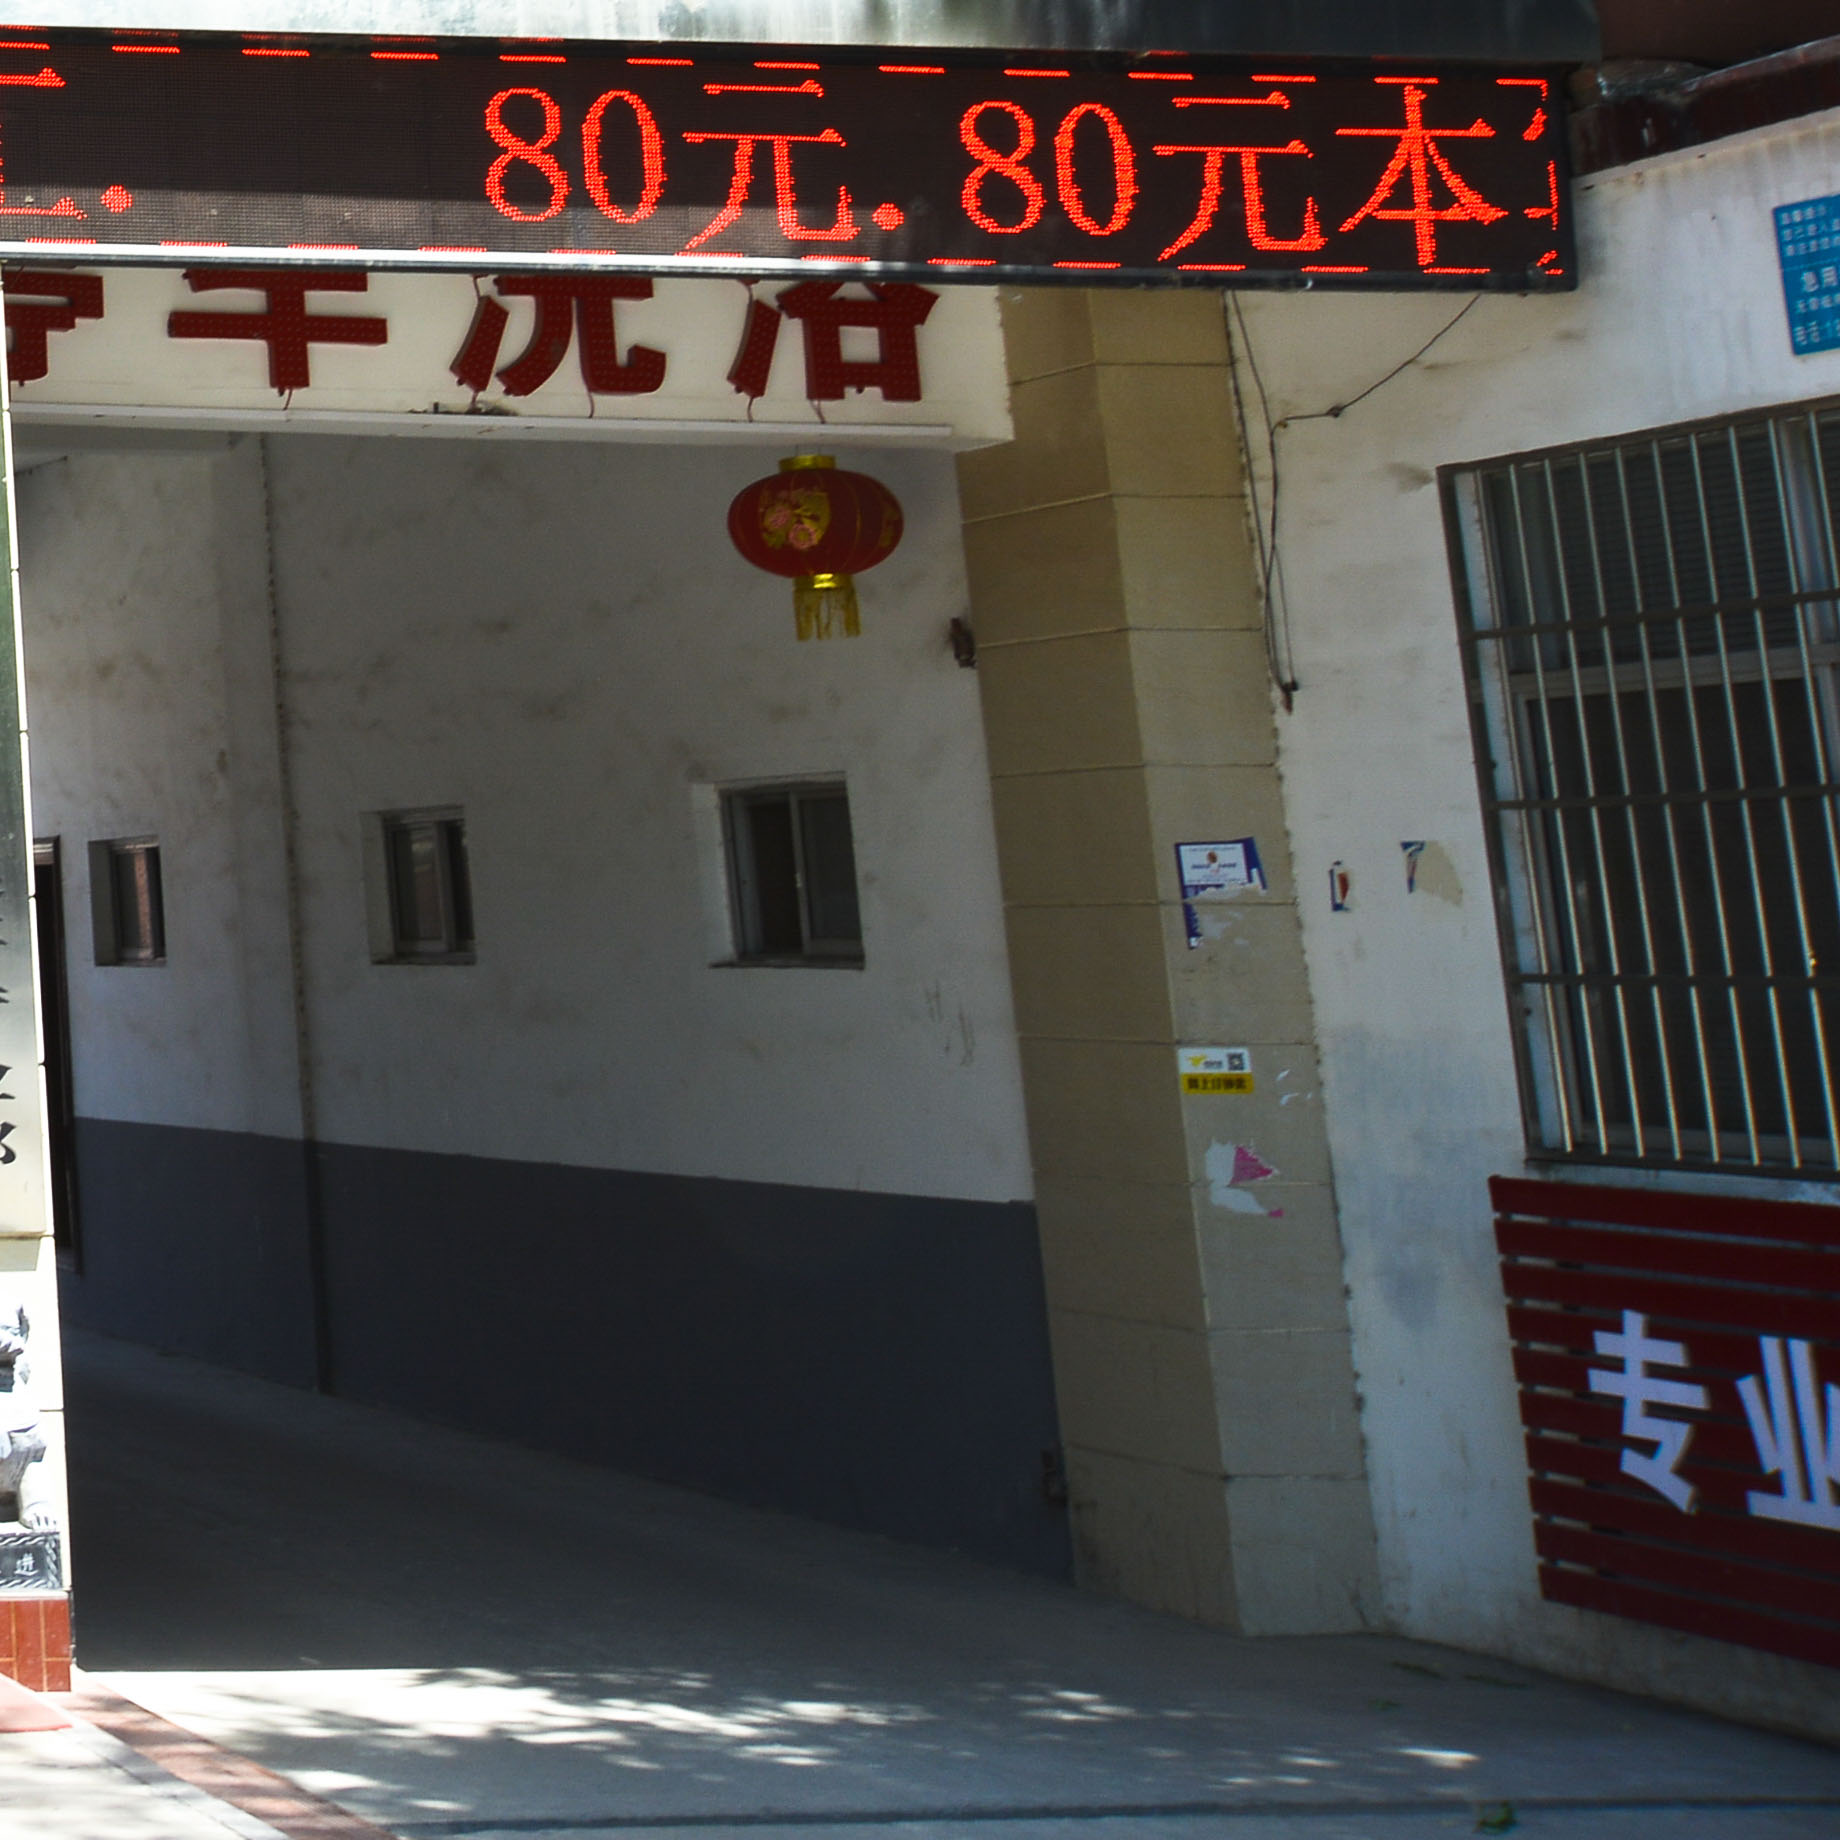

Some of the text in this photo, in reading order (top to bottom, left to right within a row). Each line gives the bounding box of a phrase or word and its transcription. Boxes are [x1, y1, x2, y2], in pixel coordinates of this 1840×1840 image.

[485, 85, 1560, 270] 80元.80元本
[1589, 1310, 1840, 1530] 专业
